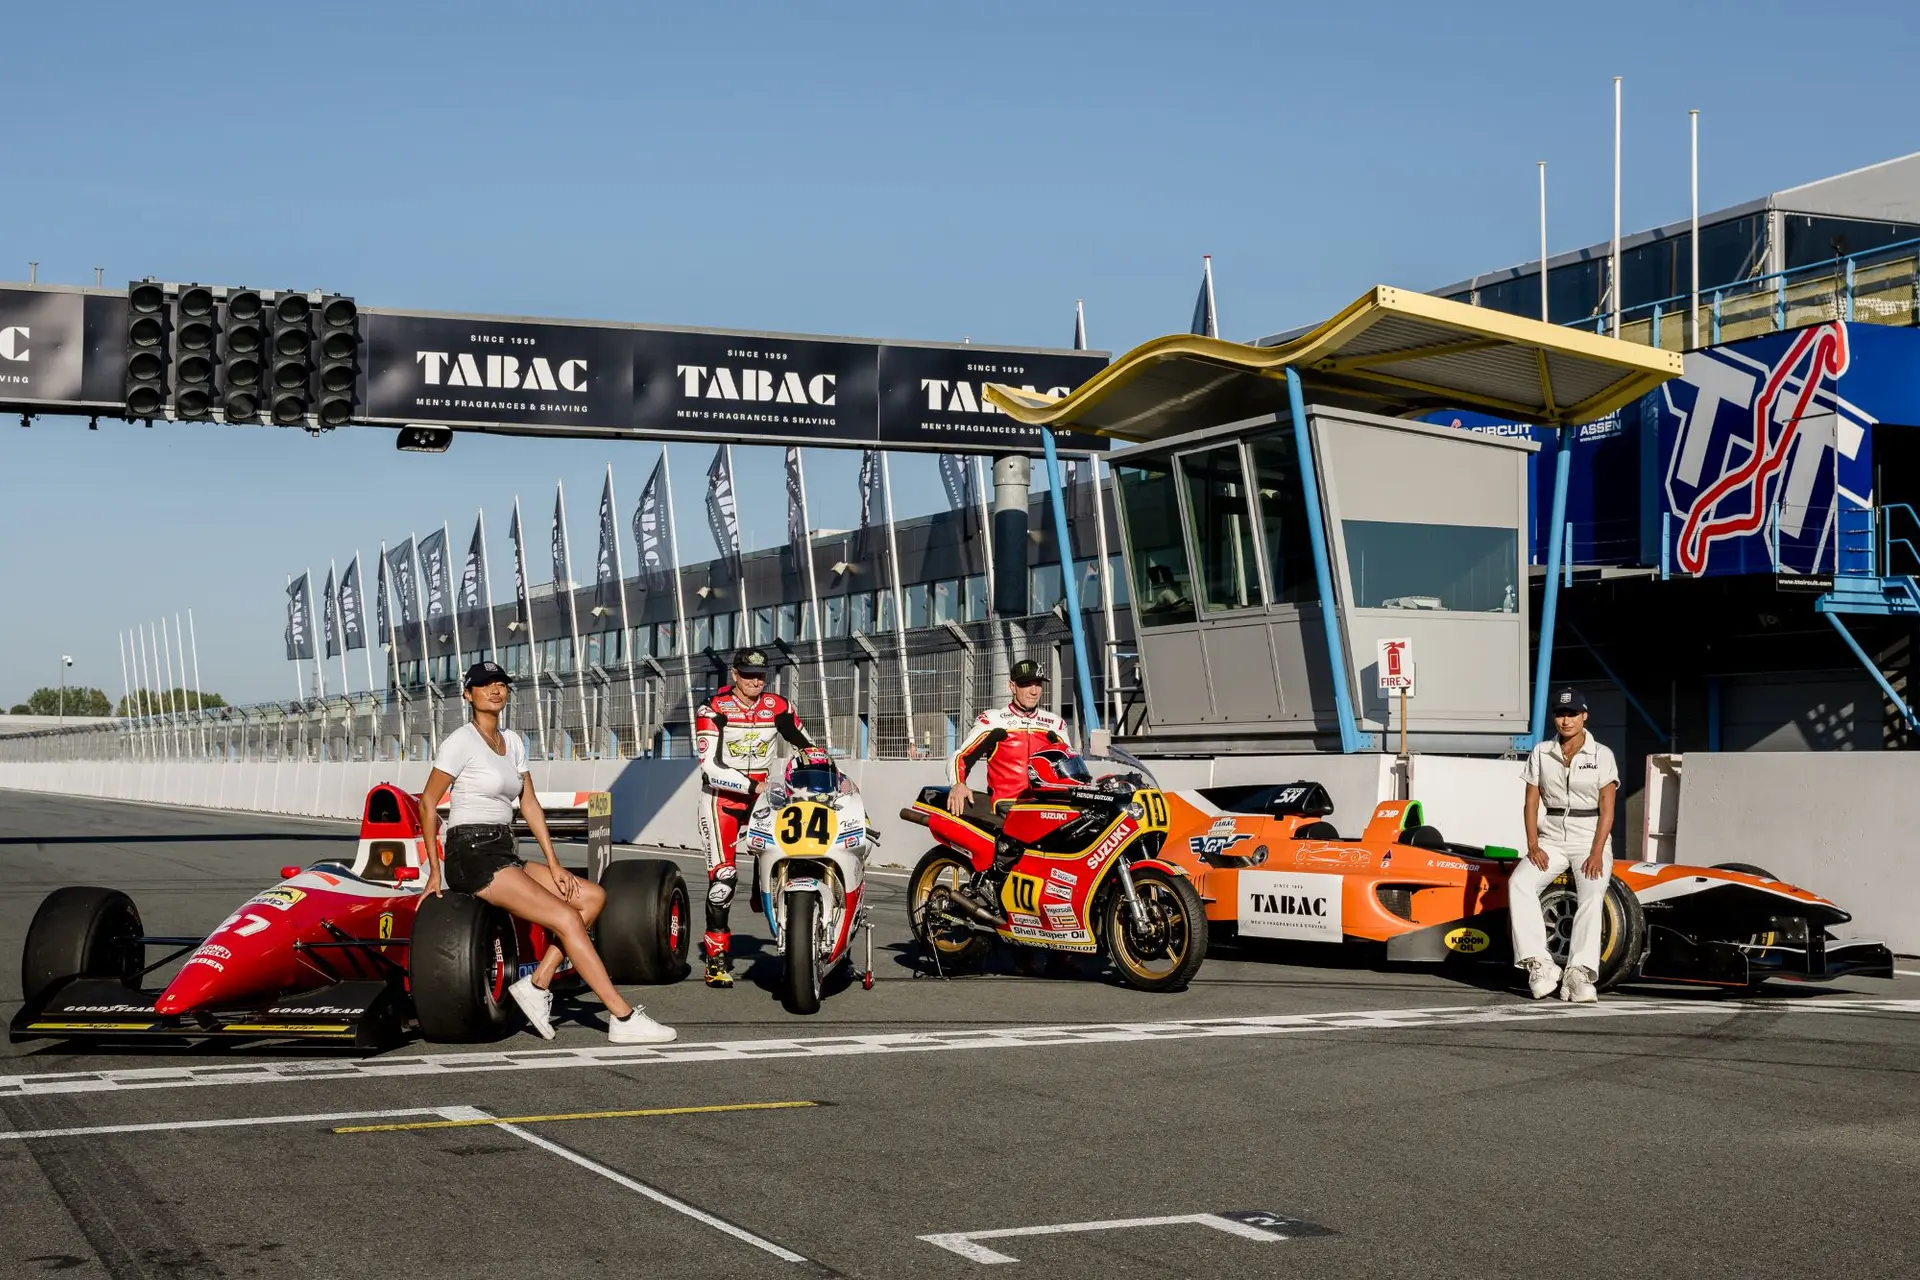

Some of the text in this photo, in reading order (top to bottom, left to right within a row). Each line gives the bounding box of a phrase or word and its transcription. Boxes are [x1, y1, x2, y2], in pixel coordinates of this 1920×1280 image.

[471, 335, 504, 343] SINCE
[728, 349, 788, 360] SINCE 1959
[416, 351, 588, 392] TABAC
[967, 364, 997, 372] SINCE
[677, 364, 836, 406] TABAC
[416, 398, 451, 406] MEN'S
[455, 400, 526, 410] FRAGRANCES
[540, 404, 588, 413] SHAVING
[677, 410, 709, 418] MEN'S
[713, 412, 780, 422] FRAGRANCES
[792, 417, 836, 425] SHAVING
[921, 422, 951, 431] MEN'S
[955, 424, 1017, 434] FRAGRANCES
[1029, 428, 1071, 436] SHNG
[1580, 419, 1621, 437] ASSEN
[1381, 677, 1402, 687] FIRE
[711, 778, 741, 789] SUZUKI
[1041, 812, 1067, 820] SUZUKI
[1140, 793, 1168, 828] 10
[781, 806, 830, 846] 34
[1087, 823, 1131, 870] SUZUKI
[1012, 875, 1036, 913] 10
[1251, 893, 1327, 917] TABAC
[1013, 926, 1085, 939] Shell Super Oil
[1451, 936, 1484, 944] KROON
[1059, 944, 1096, 952] DUNLOP
[189, 957, 224, 973] EBER
[64, 1004, 155, 1013] GOODYEAR
[268, 1005, 365, 1014] GOODYEAR
